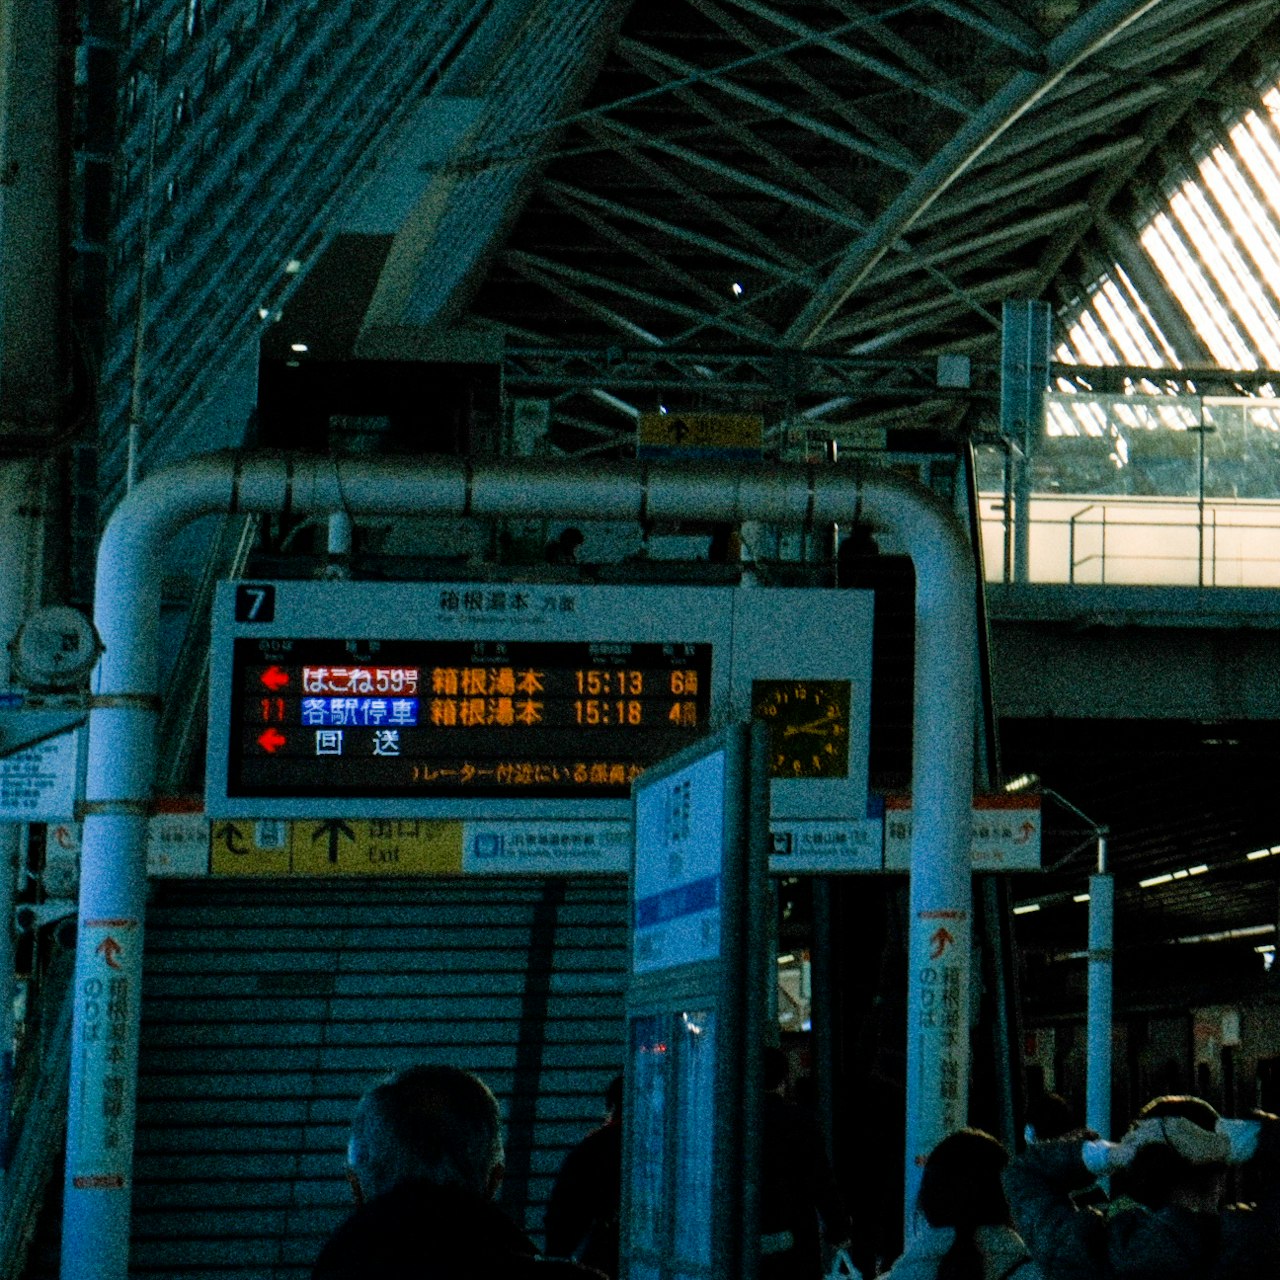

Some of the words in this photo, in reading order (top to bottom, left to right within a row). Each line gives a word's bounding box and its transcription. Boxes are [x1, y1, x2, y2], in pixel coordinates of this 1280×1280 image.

[245, 588, 268, 620] 7
[440, 589, 530, 613] 箱根湯本
[303, 666, 419, 694] はこね59号
[430, 667, 545, 696] 箱根湯本
[574, 669, 644, 696] 15:13
[261, 697, 285, 722] 11
[302, 698, 417, 726] 各駅停車
[429, 696, 545, 727] 箱根湯本
[573, 699, 644, 726] 15:18
